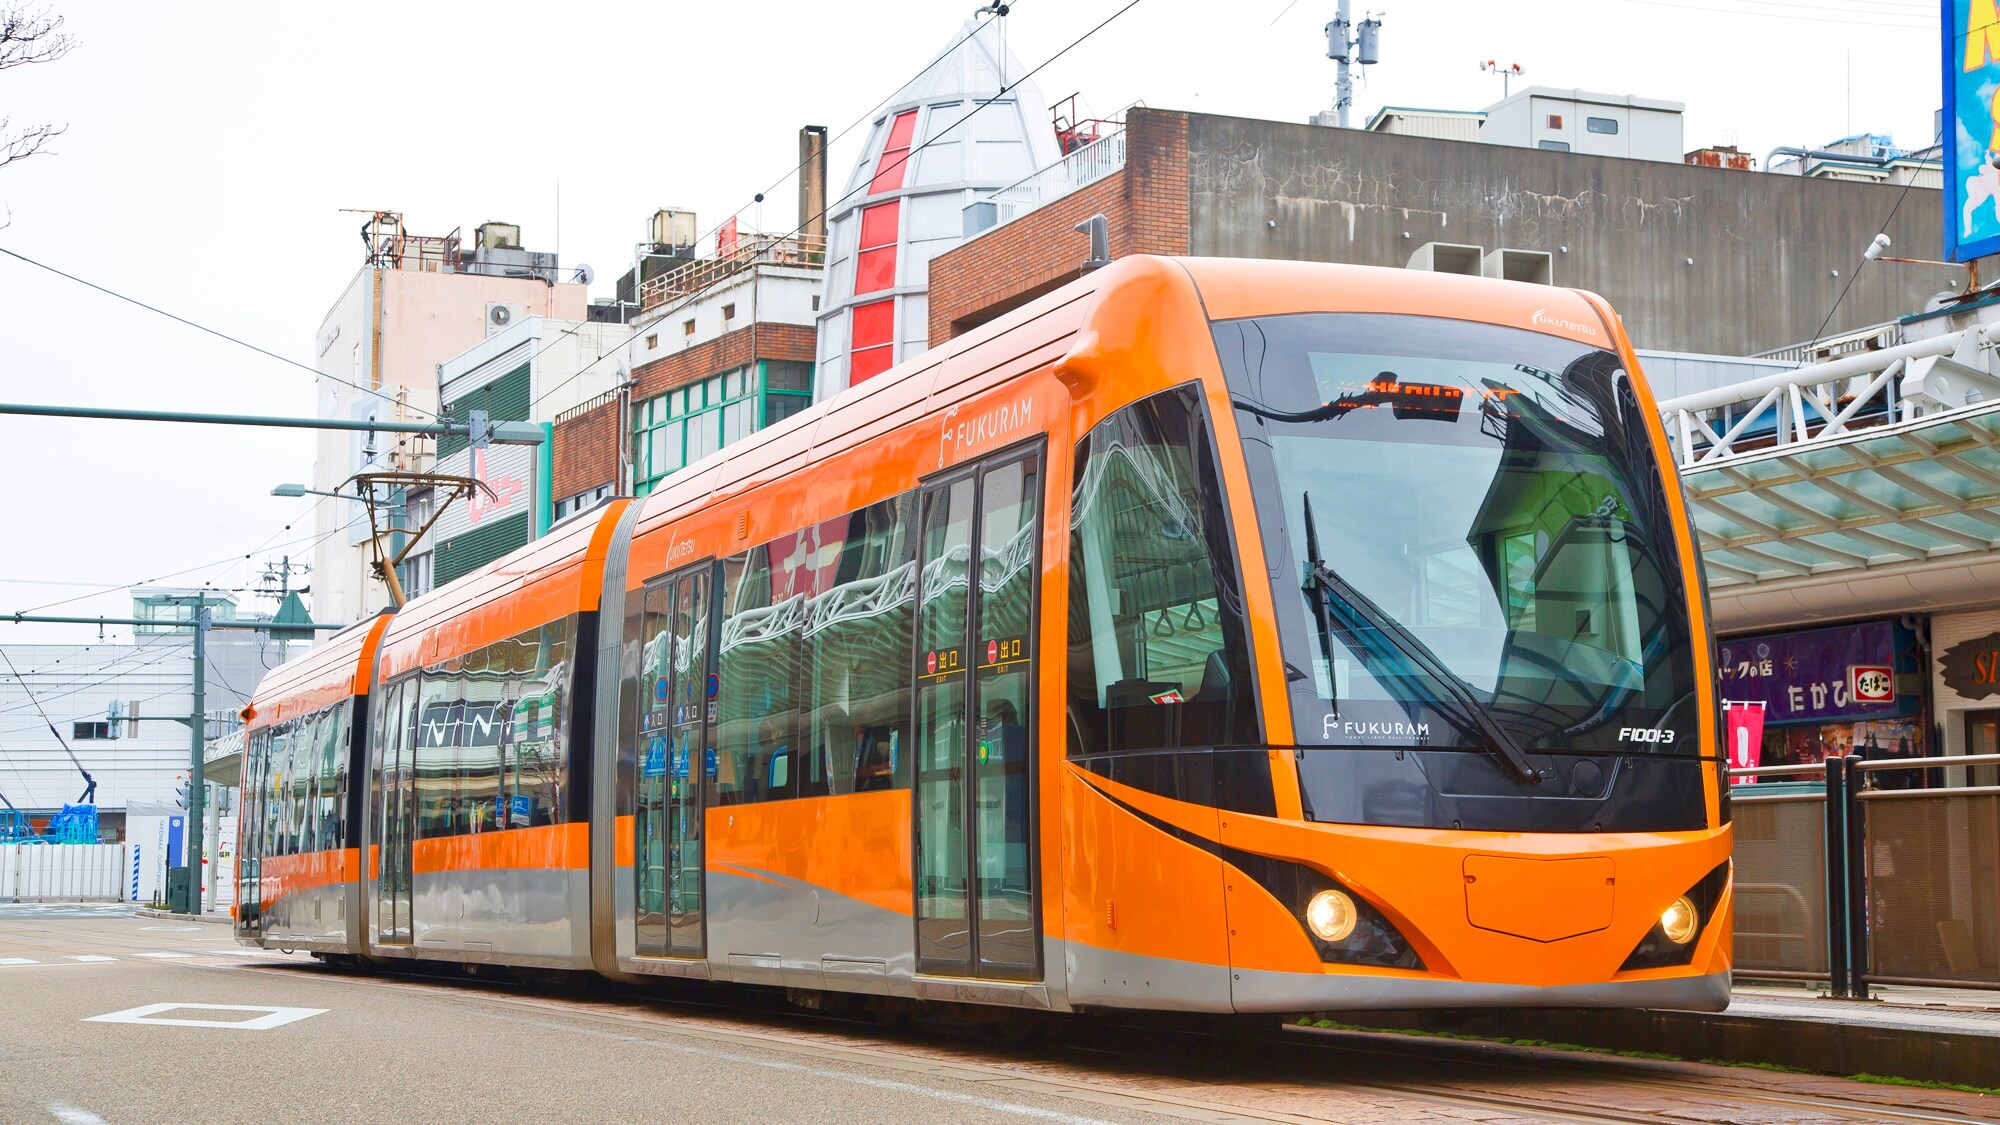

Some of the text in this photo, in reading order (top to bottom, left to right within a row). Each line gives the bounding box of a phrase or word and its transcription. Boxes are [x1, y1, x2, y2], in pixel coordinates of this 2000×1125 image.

[1532, 308, 1596, 336] FUKUTETSU
[956, 396, 1032, 451] FUKURAM
[1000, 639, 1021, 660] 出口
[938, 650, 958, 670] 出口
[1973, 650, 2000, 685] SI
[997, 665, 1009, 674] EXIT
[935, 675, 947, 684] EXIT
[1859, 675, 1889, 693] たばこ
[650, 713, 663, 728] 入口
[685, 705, 698, 720] 入口
[1344, 722, 1429, 736] FUKURAM
[1618, 728, 1675, 744] F1001-3
